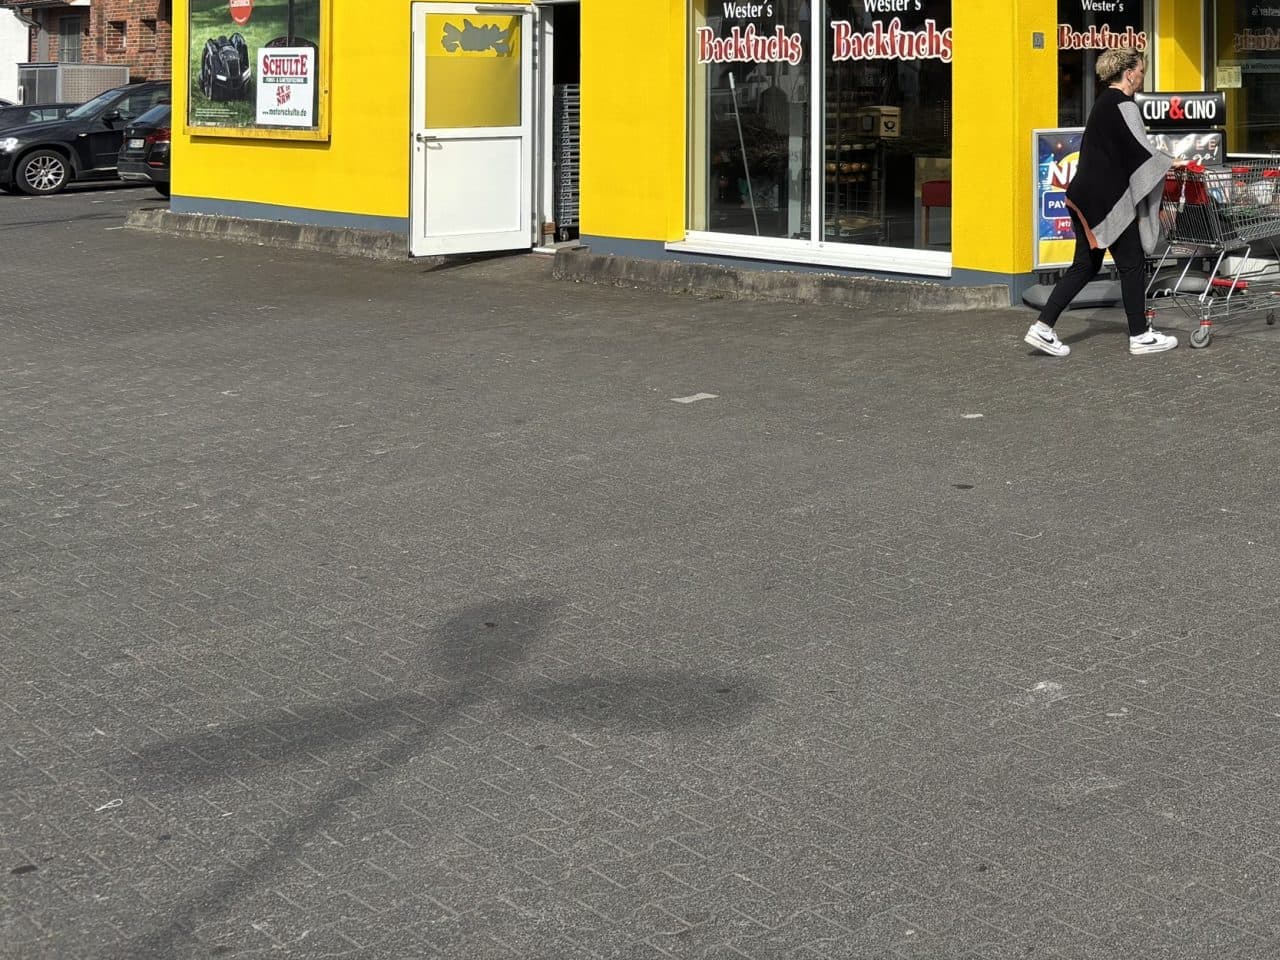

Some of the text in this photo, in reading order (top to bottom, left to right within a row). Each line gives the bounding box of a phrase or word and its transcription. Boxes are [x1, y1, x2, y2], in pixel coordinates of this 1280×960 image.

[697, 24, 802, 65] Backfuchs
[831, 17, 952, 63] Backfuchs
[1057, 23, 1147, 51] Backfuchs
[263, 54, 308, 76] SCHULTE
[1143, 96, 1216, 120] CUP&CINO
